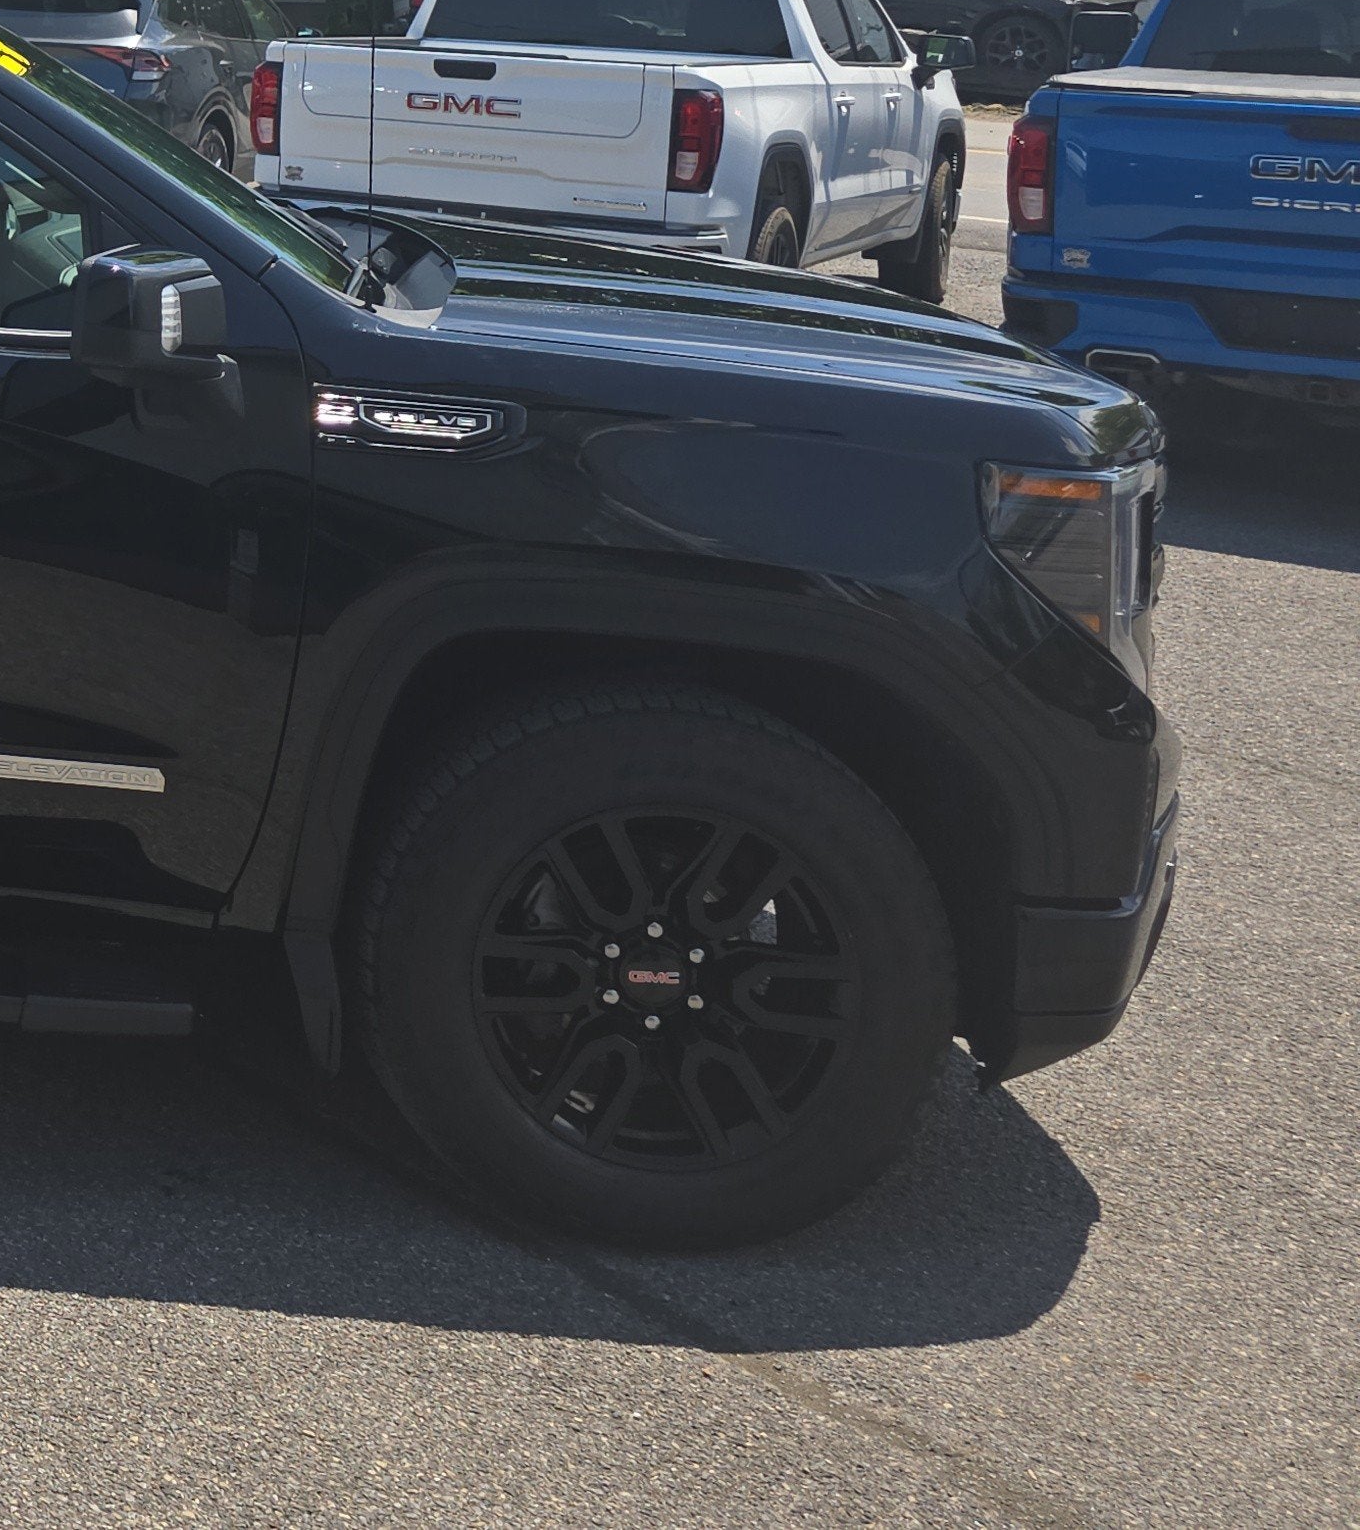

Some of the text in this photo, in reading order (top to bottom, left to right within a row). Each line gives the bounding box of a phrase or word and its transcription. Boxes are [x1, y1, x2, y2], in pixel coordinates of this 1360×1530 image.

[405, 92, 522, 119] GMC
[1251, 196, 1360, 213] SIER
[628, 970, 680, 984] GMC
